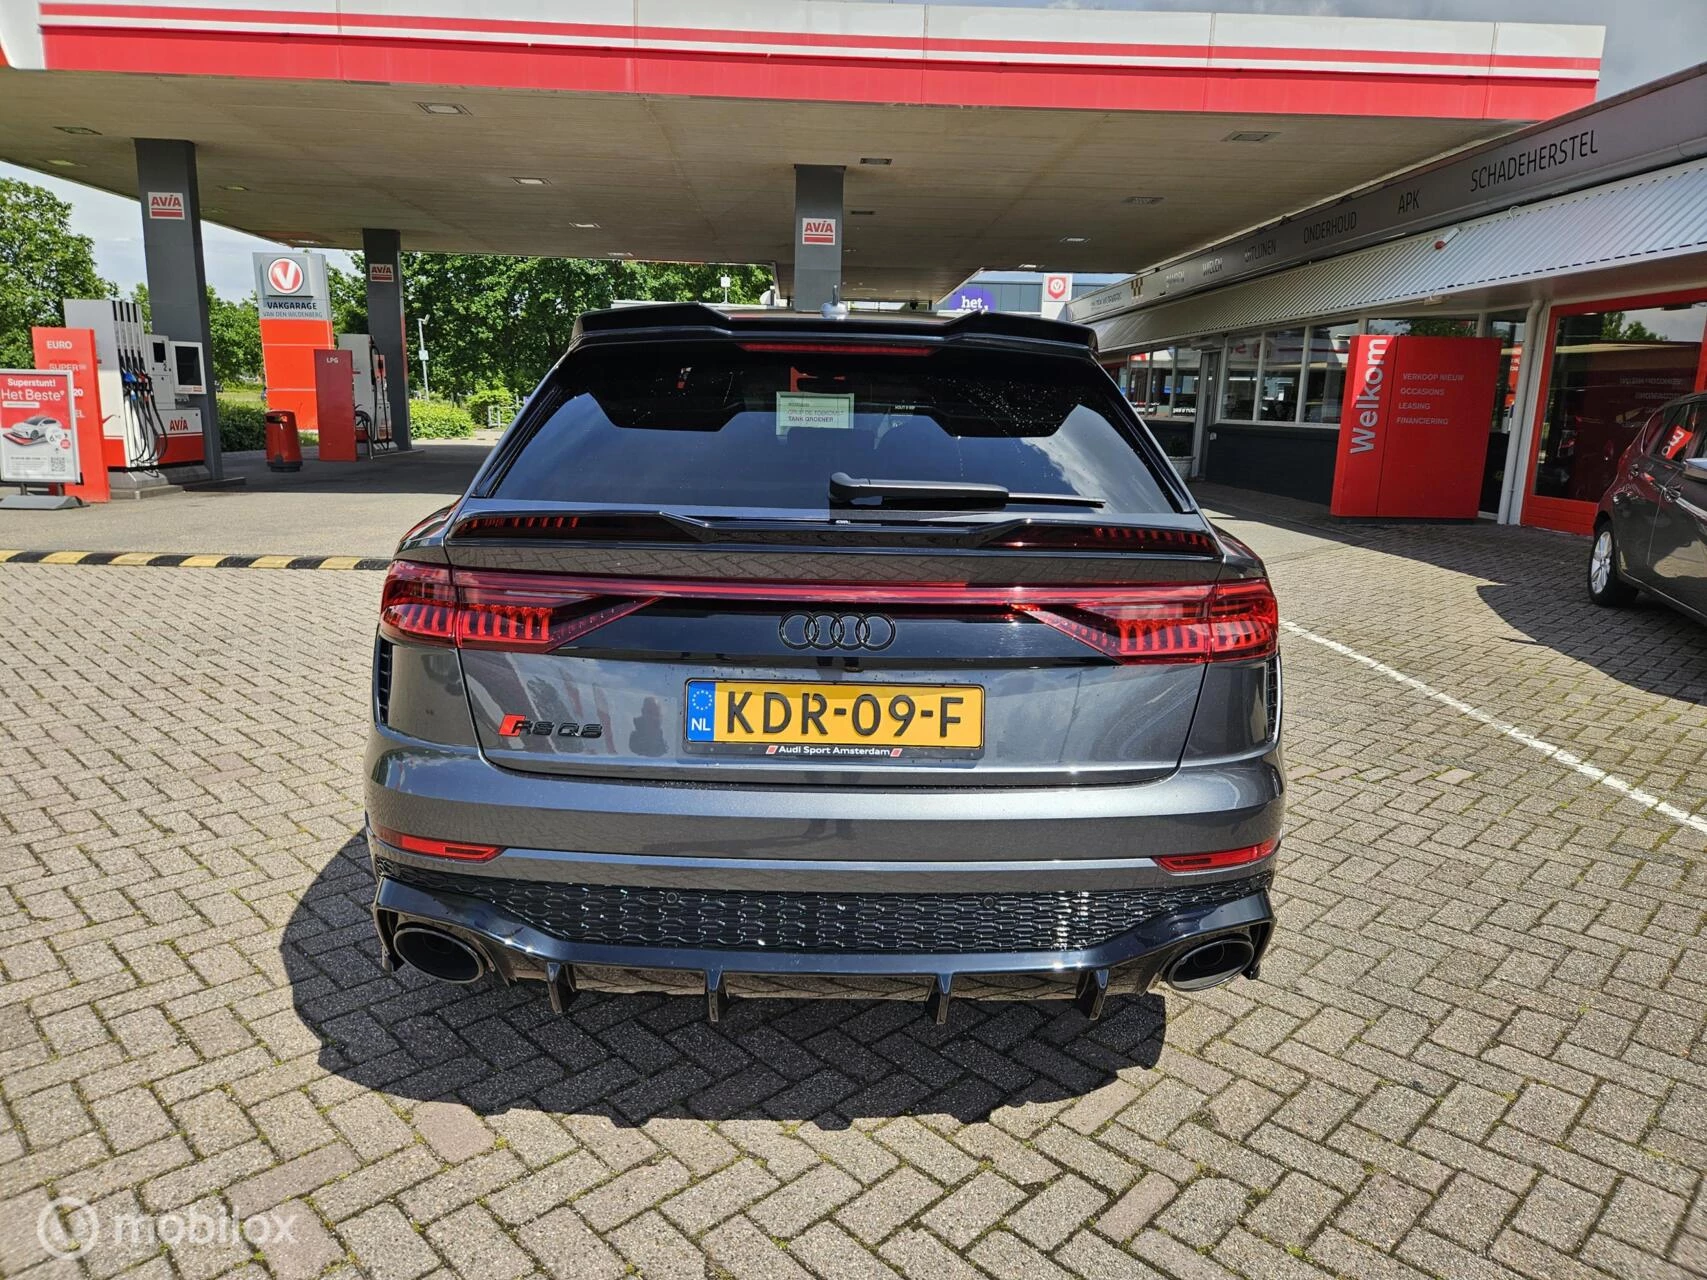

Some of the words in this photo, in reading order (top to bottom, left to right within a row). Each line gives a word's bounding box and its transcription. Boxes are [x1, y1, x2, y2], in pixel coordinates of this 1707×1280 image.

[1470, 130, 1598, 192] SCHADEHERSTEL
[1398, 190, 1420, 215] APK
[1303, 211, 1357, 244] ONDERHOUD
[267, 301, 317, 310] VAKGARAGE
[962, 296, 982, 309] het
[46, 340, 72, 350] EURO
[7, 378, 56, 387] Superstunt!
[1402, 373, 1440, 381] VERKOOP
[1440, 373, 1464, 382] NIEUW
[1, 388, 24, 400] Het
[1350, 338, 1387, 454] Welkom
[1400, 388, 1445, 396] OCCASIONS
[1398, 402, 1431, 410] LEASING
[169, 417, 189, 431] AVIA
[726, 690, 965, 738] KDR-09-F
[691, 717, 711, 732] NL
[778, 745, 801, 754] Audi
[803, 746, 831, 757] Sport
[832, 747, 890, 756] Amsterdam
